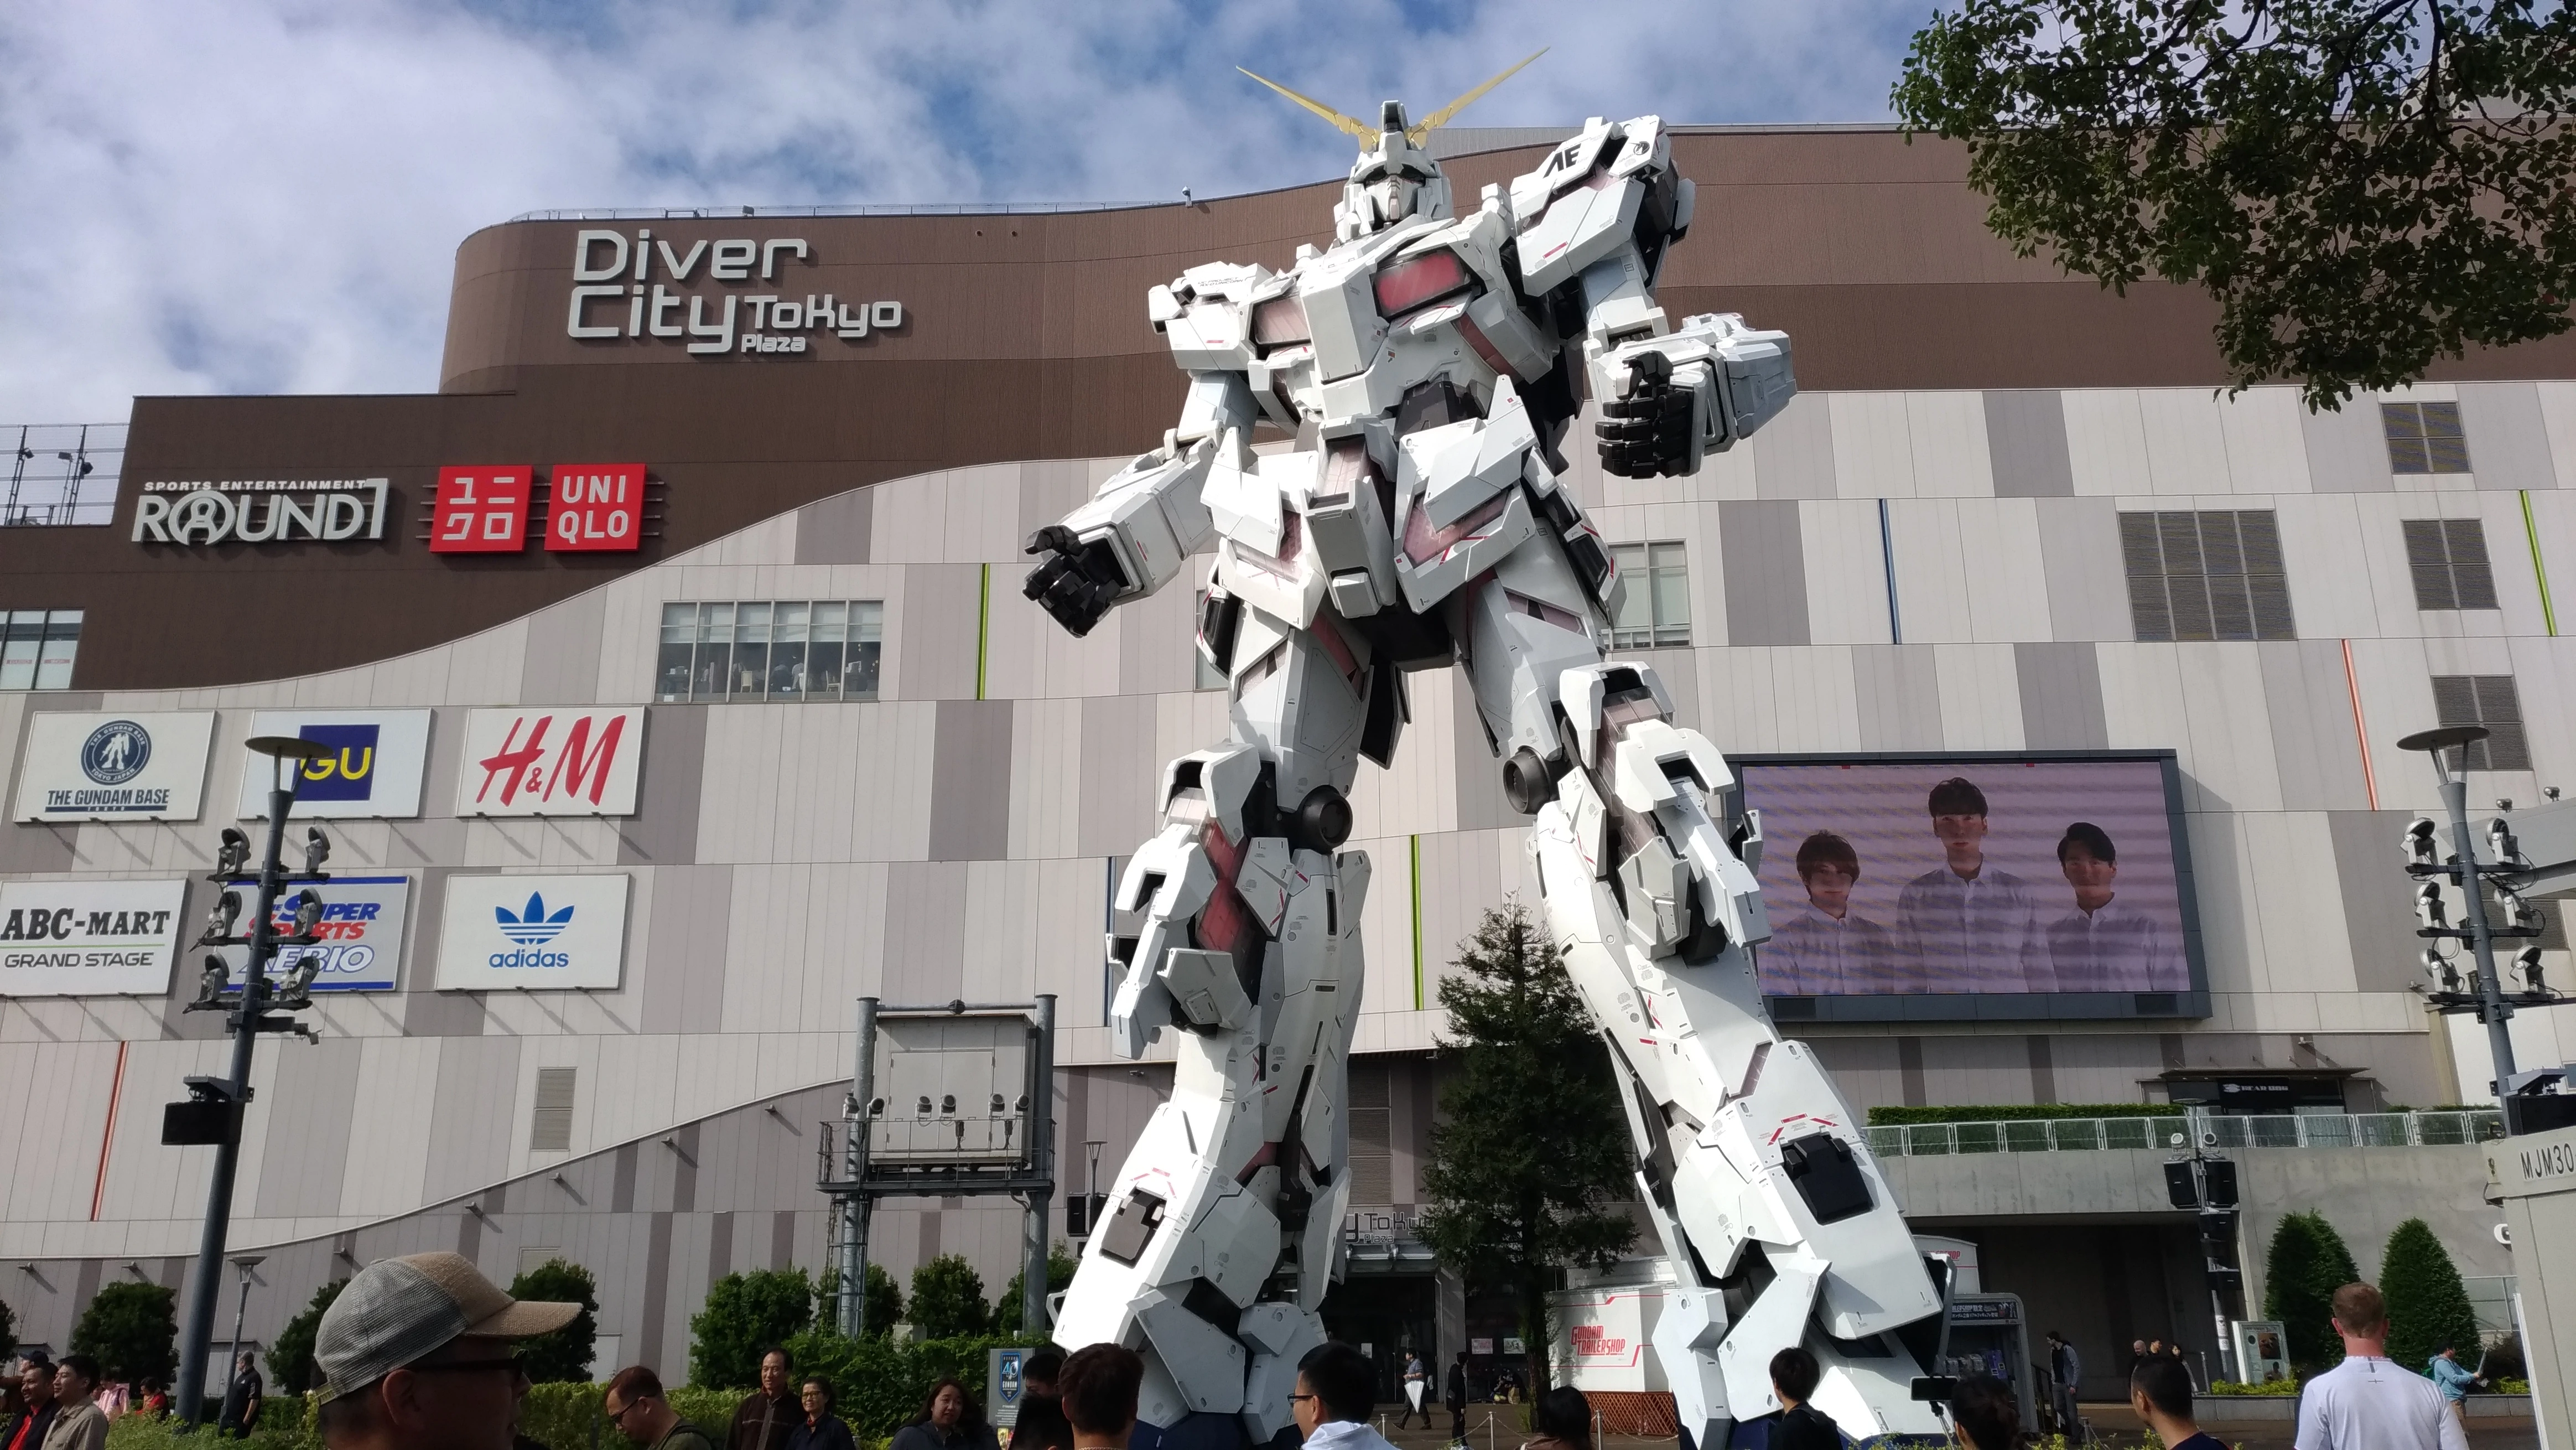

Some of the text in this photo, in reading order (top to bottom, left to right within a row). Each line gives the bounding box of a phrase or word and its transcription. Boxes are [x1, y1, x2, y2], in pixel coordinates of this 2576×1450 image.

[573, 229, 807, 281] Diver
[568, 284, 736, 353] City
[741, 333, 806, 353] Plaza
[144, 480, 366, 491] SPORTS ENTERTAINMENT
[562, 475, 626, 504] UNI
[558, 510, 629, 544] QLO
[476, 715, 626, 807] H&M
[92, 768, 135, 781] TOKYO JAPAN
[48, 789, 170, 805] THE GUNDAM BASE
[0, 908, 170, 940] ABC-MART
[4, 952, 154, 968] GRAND STAGE
[489, 948, 569, 969] adidas
[2520, 1142, 2576, 1180] MJM30
[1364, 1233, 1394, 1244] Plaza
[1571, 1325, 1604, 1346] GUNDAM
